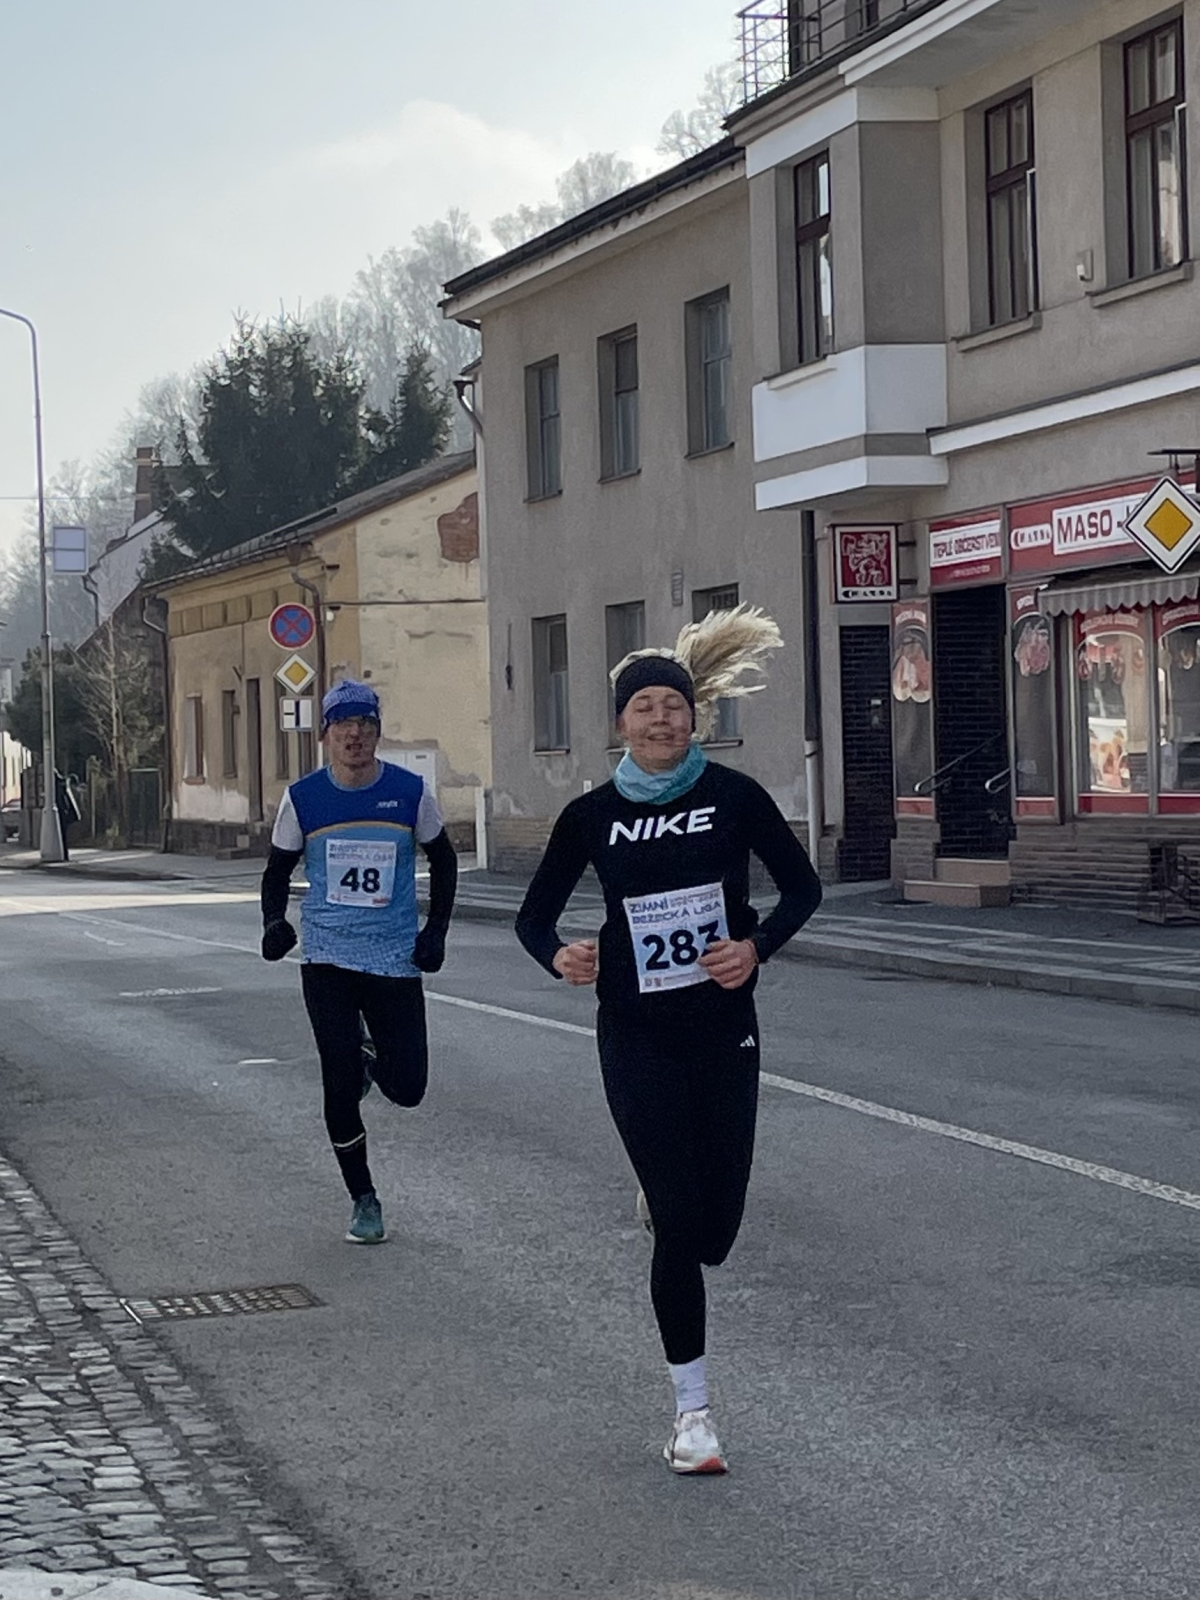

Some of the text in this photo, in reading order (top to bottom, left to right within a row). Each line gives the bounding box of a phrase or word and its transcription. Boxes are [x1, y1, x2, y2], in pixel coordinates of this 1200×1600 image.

[1057, 509, 1112, 545] MASO
[608, 806, 716, 846] NIKE
[340, 867, 380, 893] 48
